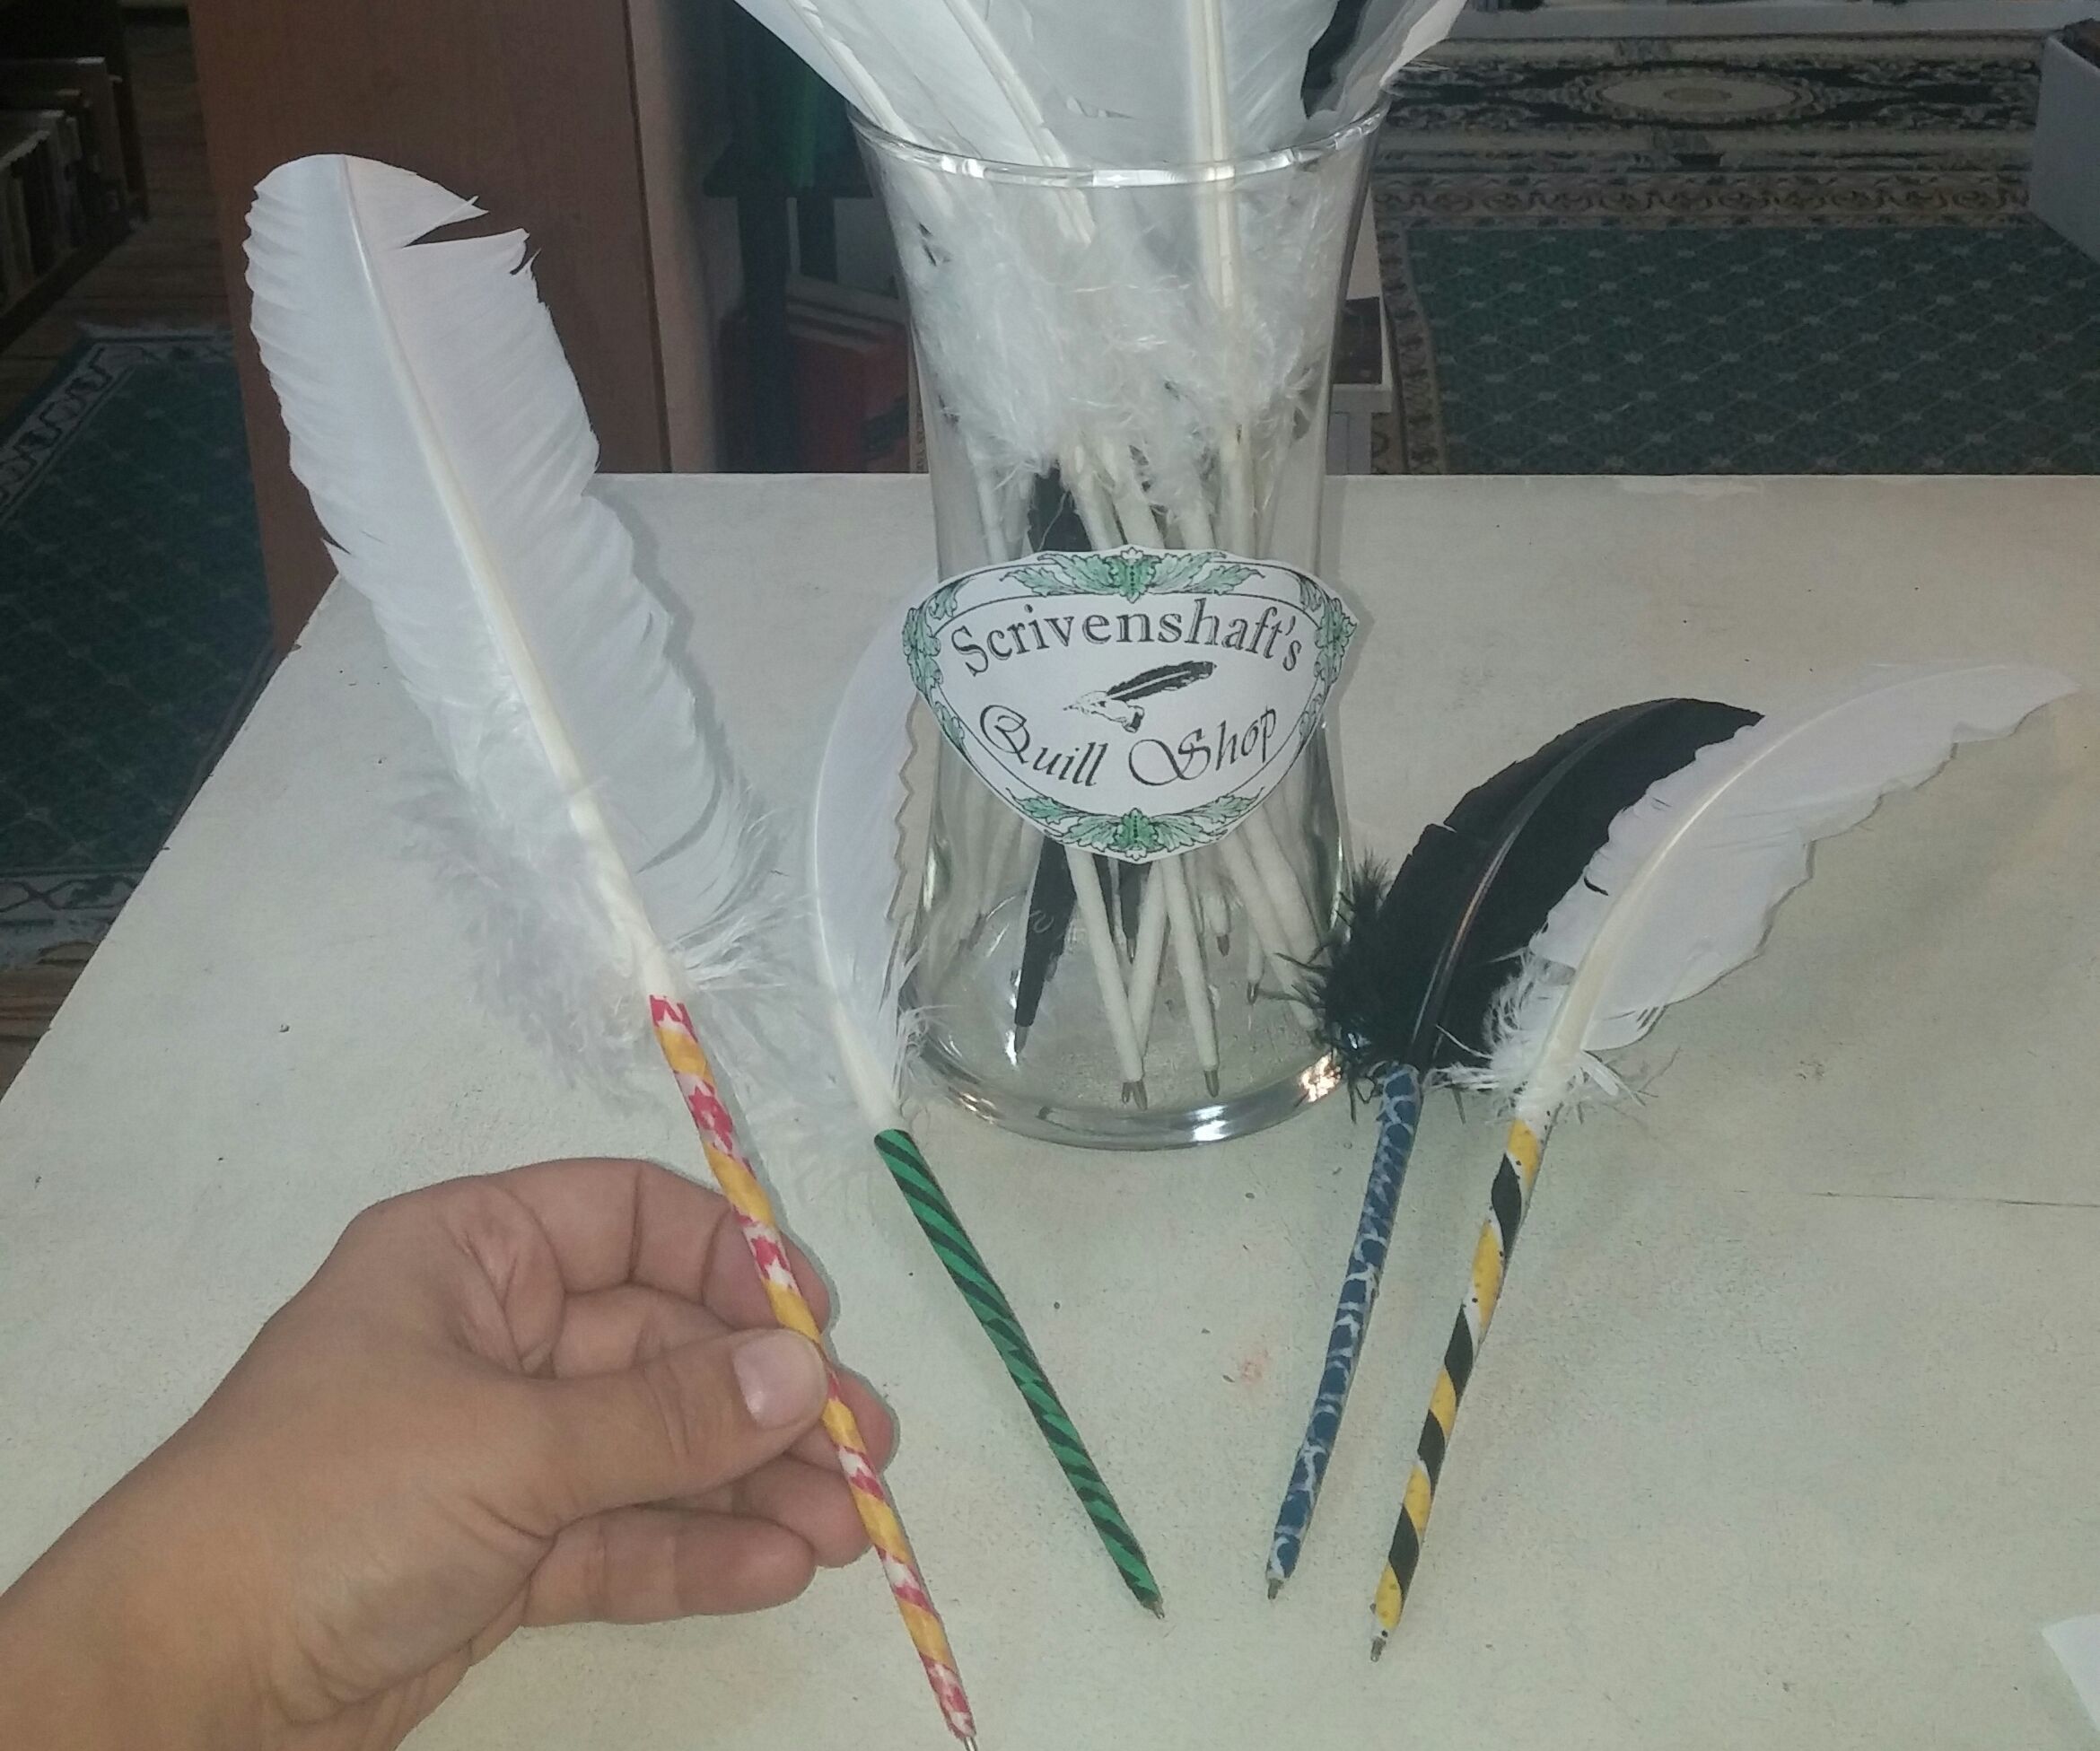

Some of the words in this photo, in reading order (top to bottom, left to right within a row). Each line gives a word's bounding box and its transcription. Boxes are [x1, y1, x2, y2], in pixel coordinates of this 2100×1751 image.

[951, 599, 1302, 677] Scrivenshaft's
[980, 705, 1108, 787] Quill
[1128, 707, 1277, 786] Shop
